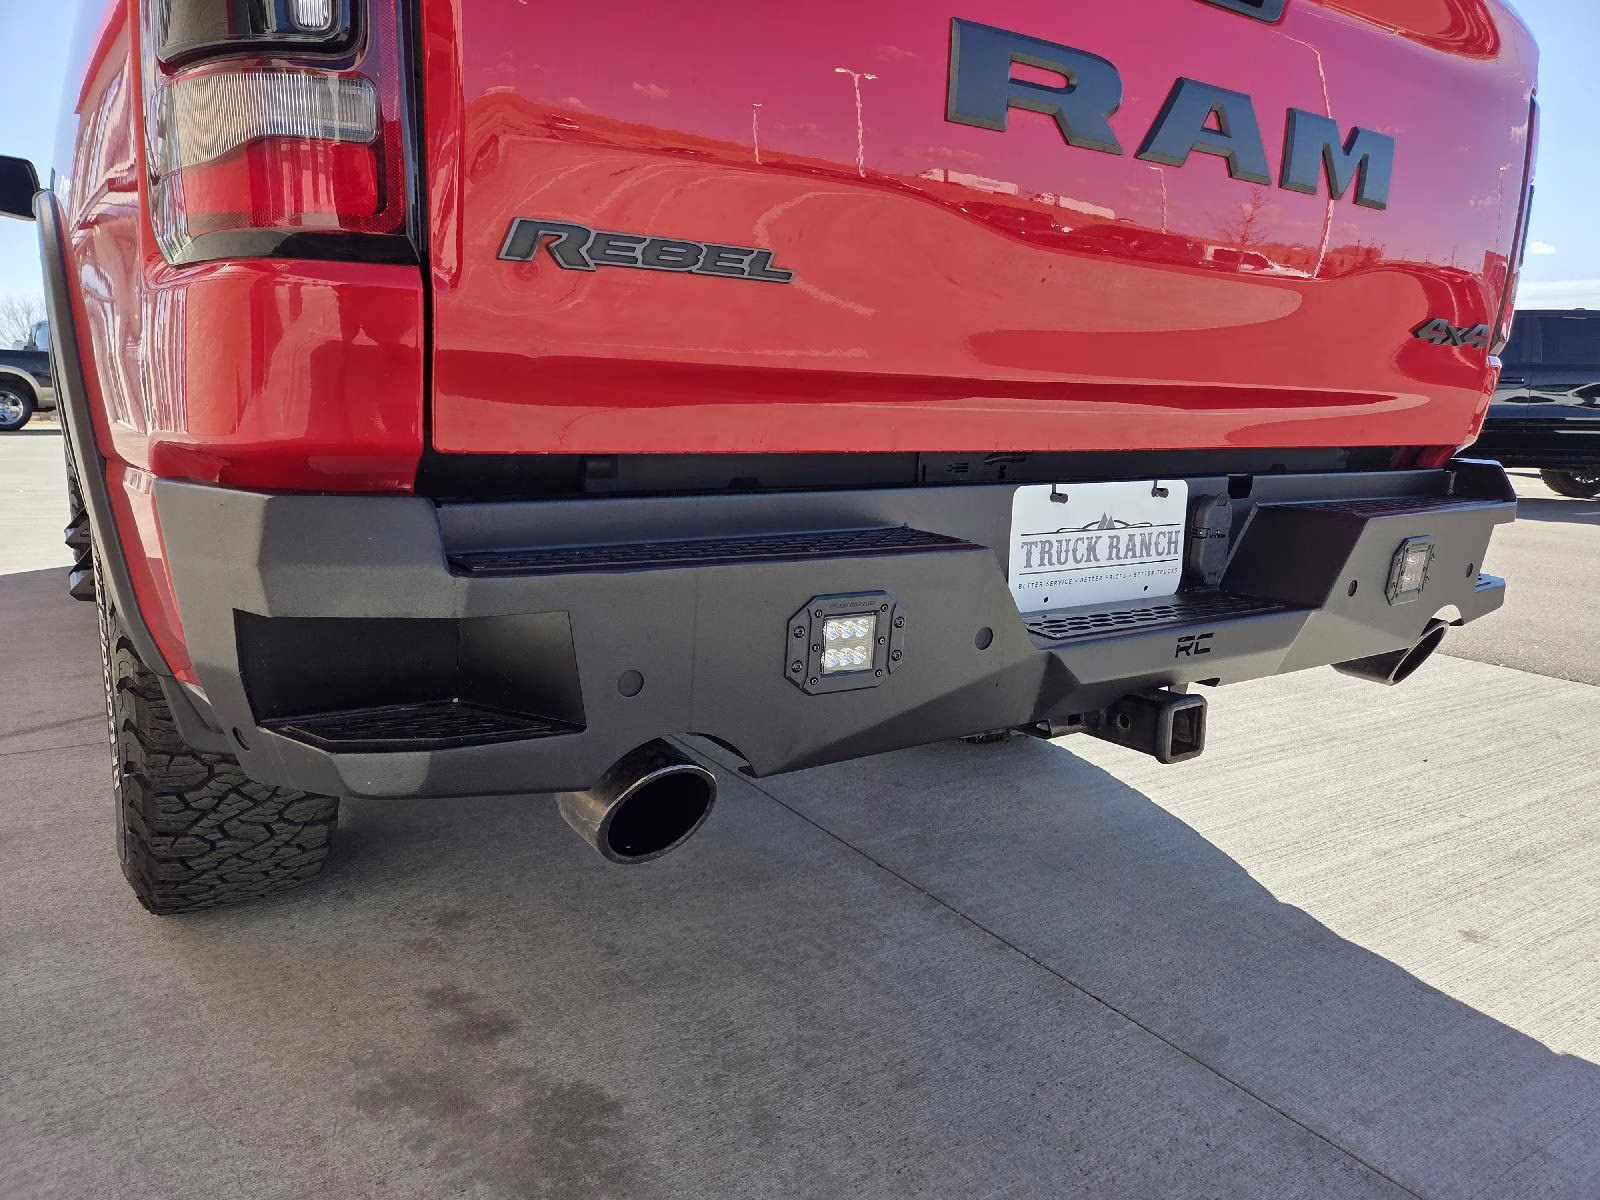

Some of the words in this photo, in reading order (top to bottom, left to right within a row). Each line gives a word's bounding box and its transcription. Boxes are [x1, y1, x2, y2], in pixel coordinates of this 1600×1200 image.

[945, 17, 1395, 210] RAM
[498, 217, 794, 283] REBEL
[1020, 536, 1102, 569] TRUCK
[1107, 529, 1181, 561] RANCH
[1174, 632, 1214, 658] RC
